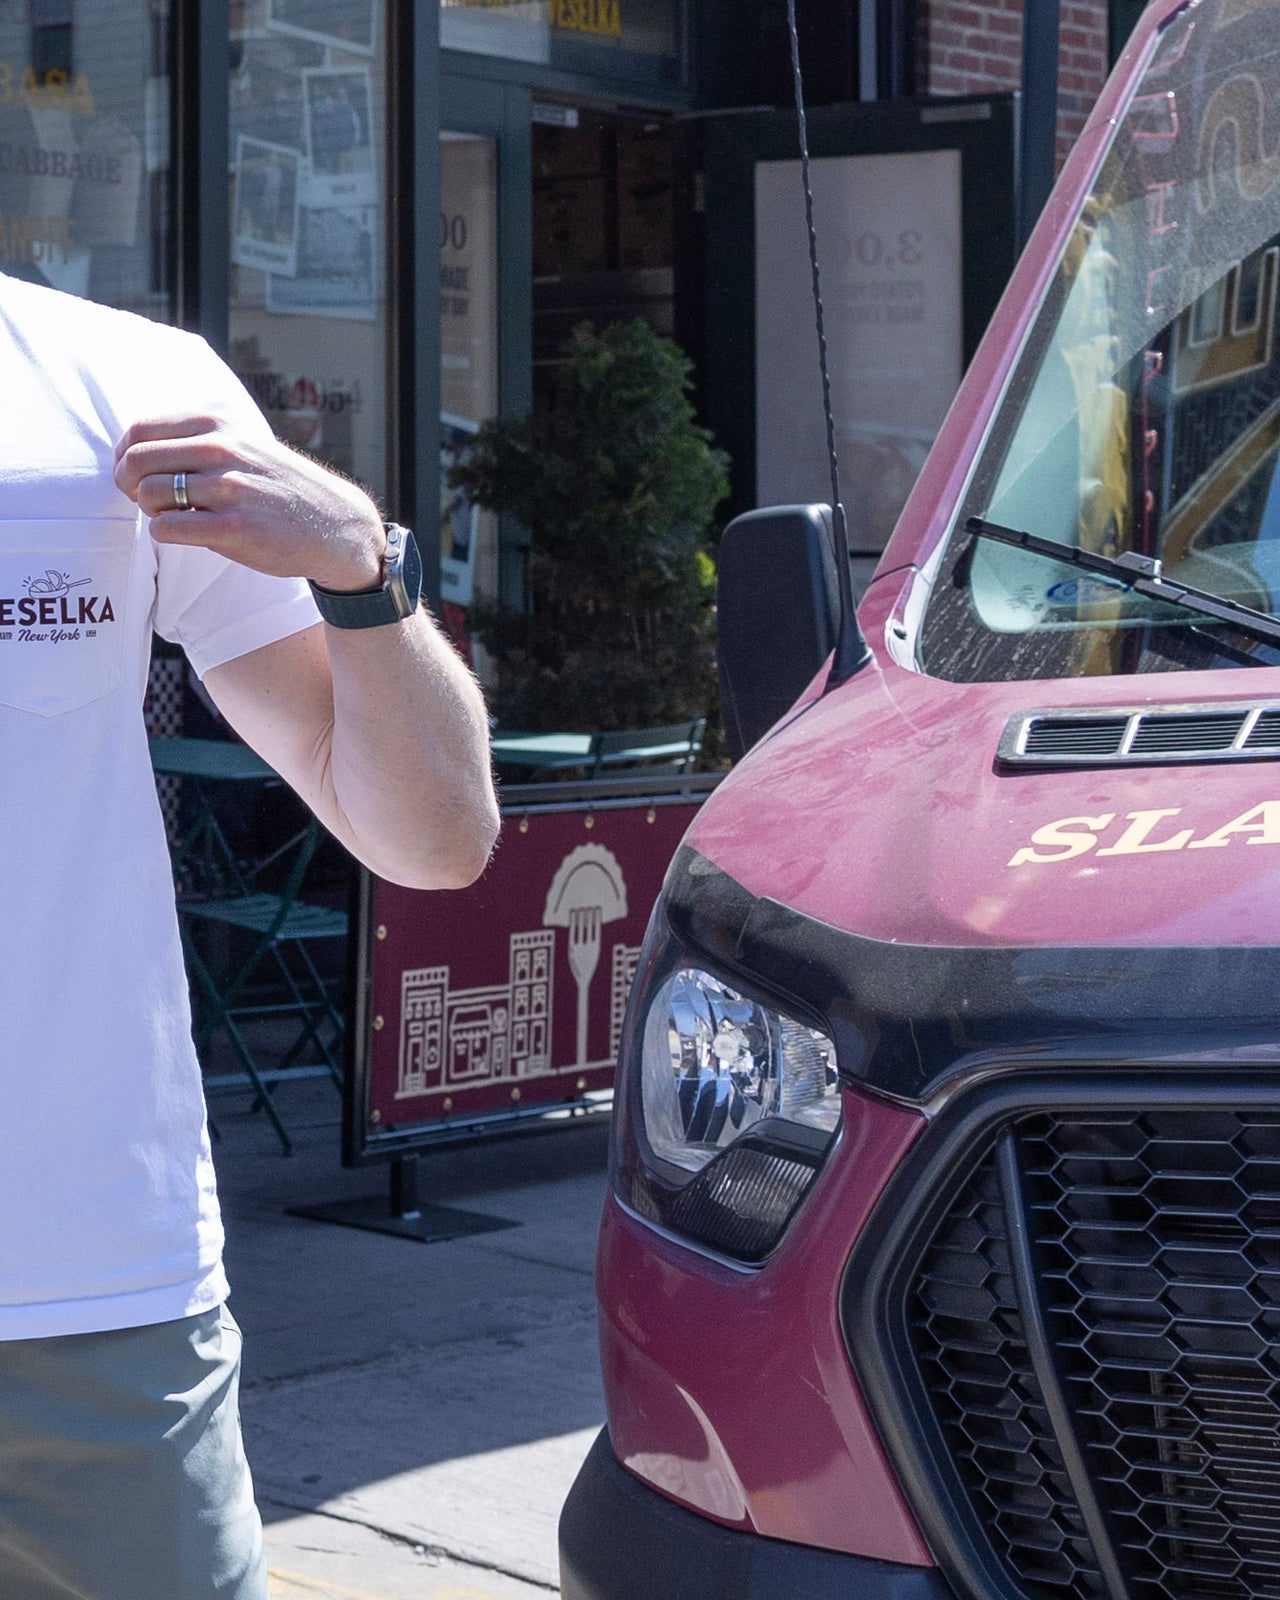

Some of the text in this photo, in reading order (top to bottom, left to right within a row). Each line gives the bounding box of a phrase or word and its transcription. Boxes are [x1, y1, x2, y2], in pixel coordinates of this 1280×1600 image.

[17, 628, 52, 643] New
[49, 627, 82, 645] York
[1006, 800, 1280, 868] SLA
